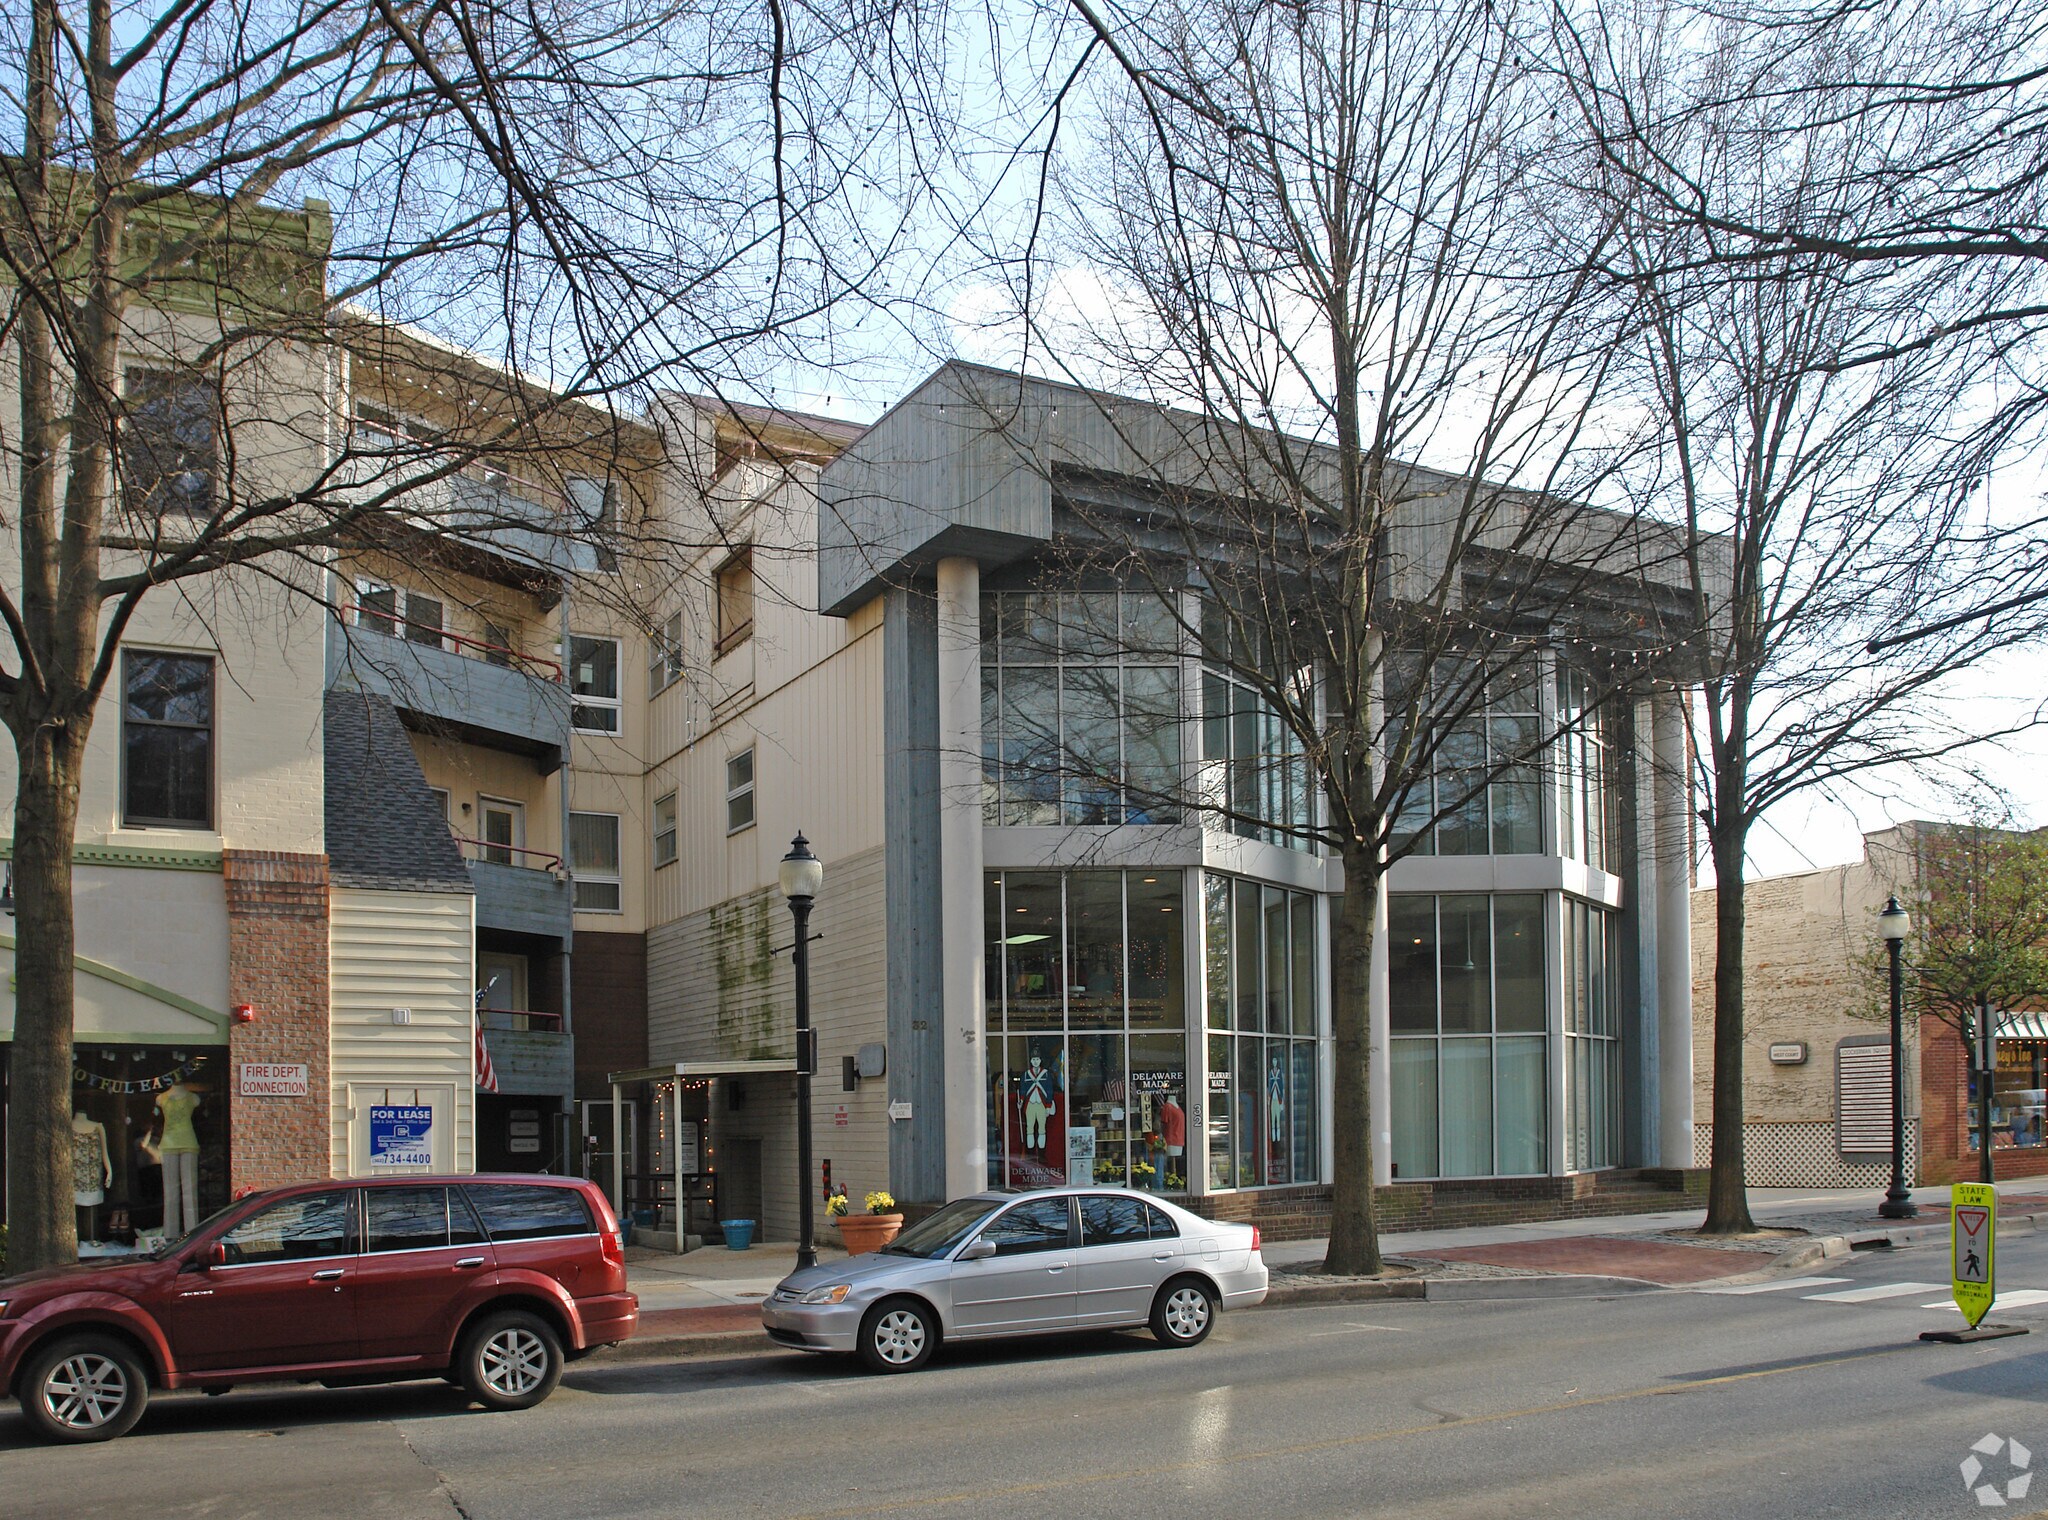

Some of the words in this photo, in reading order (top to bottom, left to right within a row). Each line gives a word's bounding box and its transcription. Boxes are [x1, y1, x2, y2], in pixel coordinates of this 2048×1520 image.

[246, 1066, 269, 1078] FIRE
[272, 1066, 302, 1078] DEPT.
[1132, 1072, 1184, 1081] DELAWARE
[243, 1081, 306, 1093] CONNECTION
[1142, 1080, 1170, 1089] MADE
[1211, 1079, 1226, 1087] MADE
[371, 1110, 395, 1119] FOR
[398, 1110, 431, 1119] LEASE
[1143, 1094, 1152, 1131] OPEN
[1193, 1104, 1202, 1128] 32
[384, 1153, 431, 1164] 734-4400
[1011, 1167, 1063, 1176] DELAWARE
[1022, 1175, 1050, 1183] MADE
[1959, 1186, 1987, 1195] STATE
[1963, 1195, 1983, 1204] LAW
